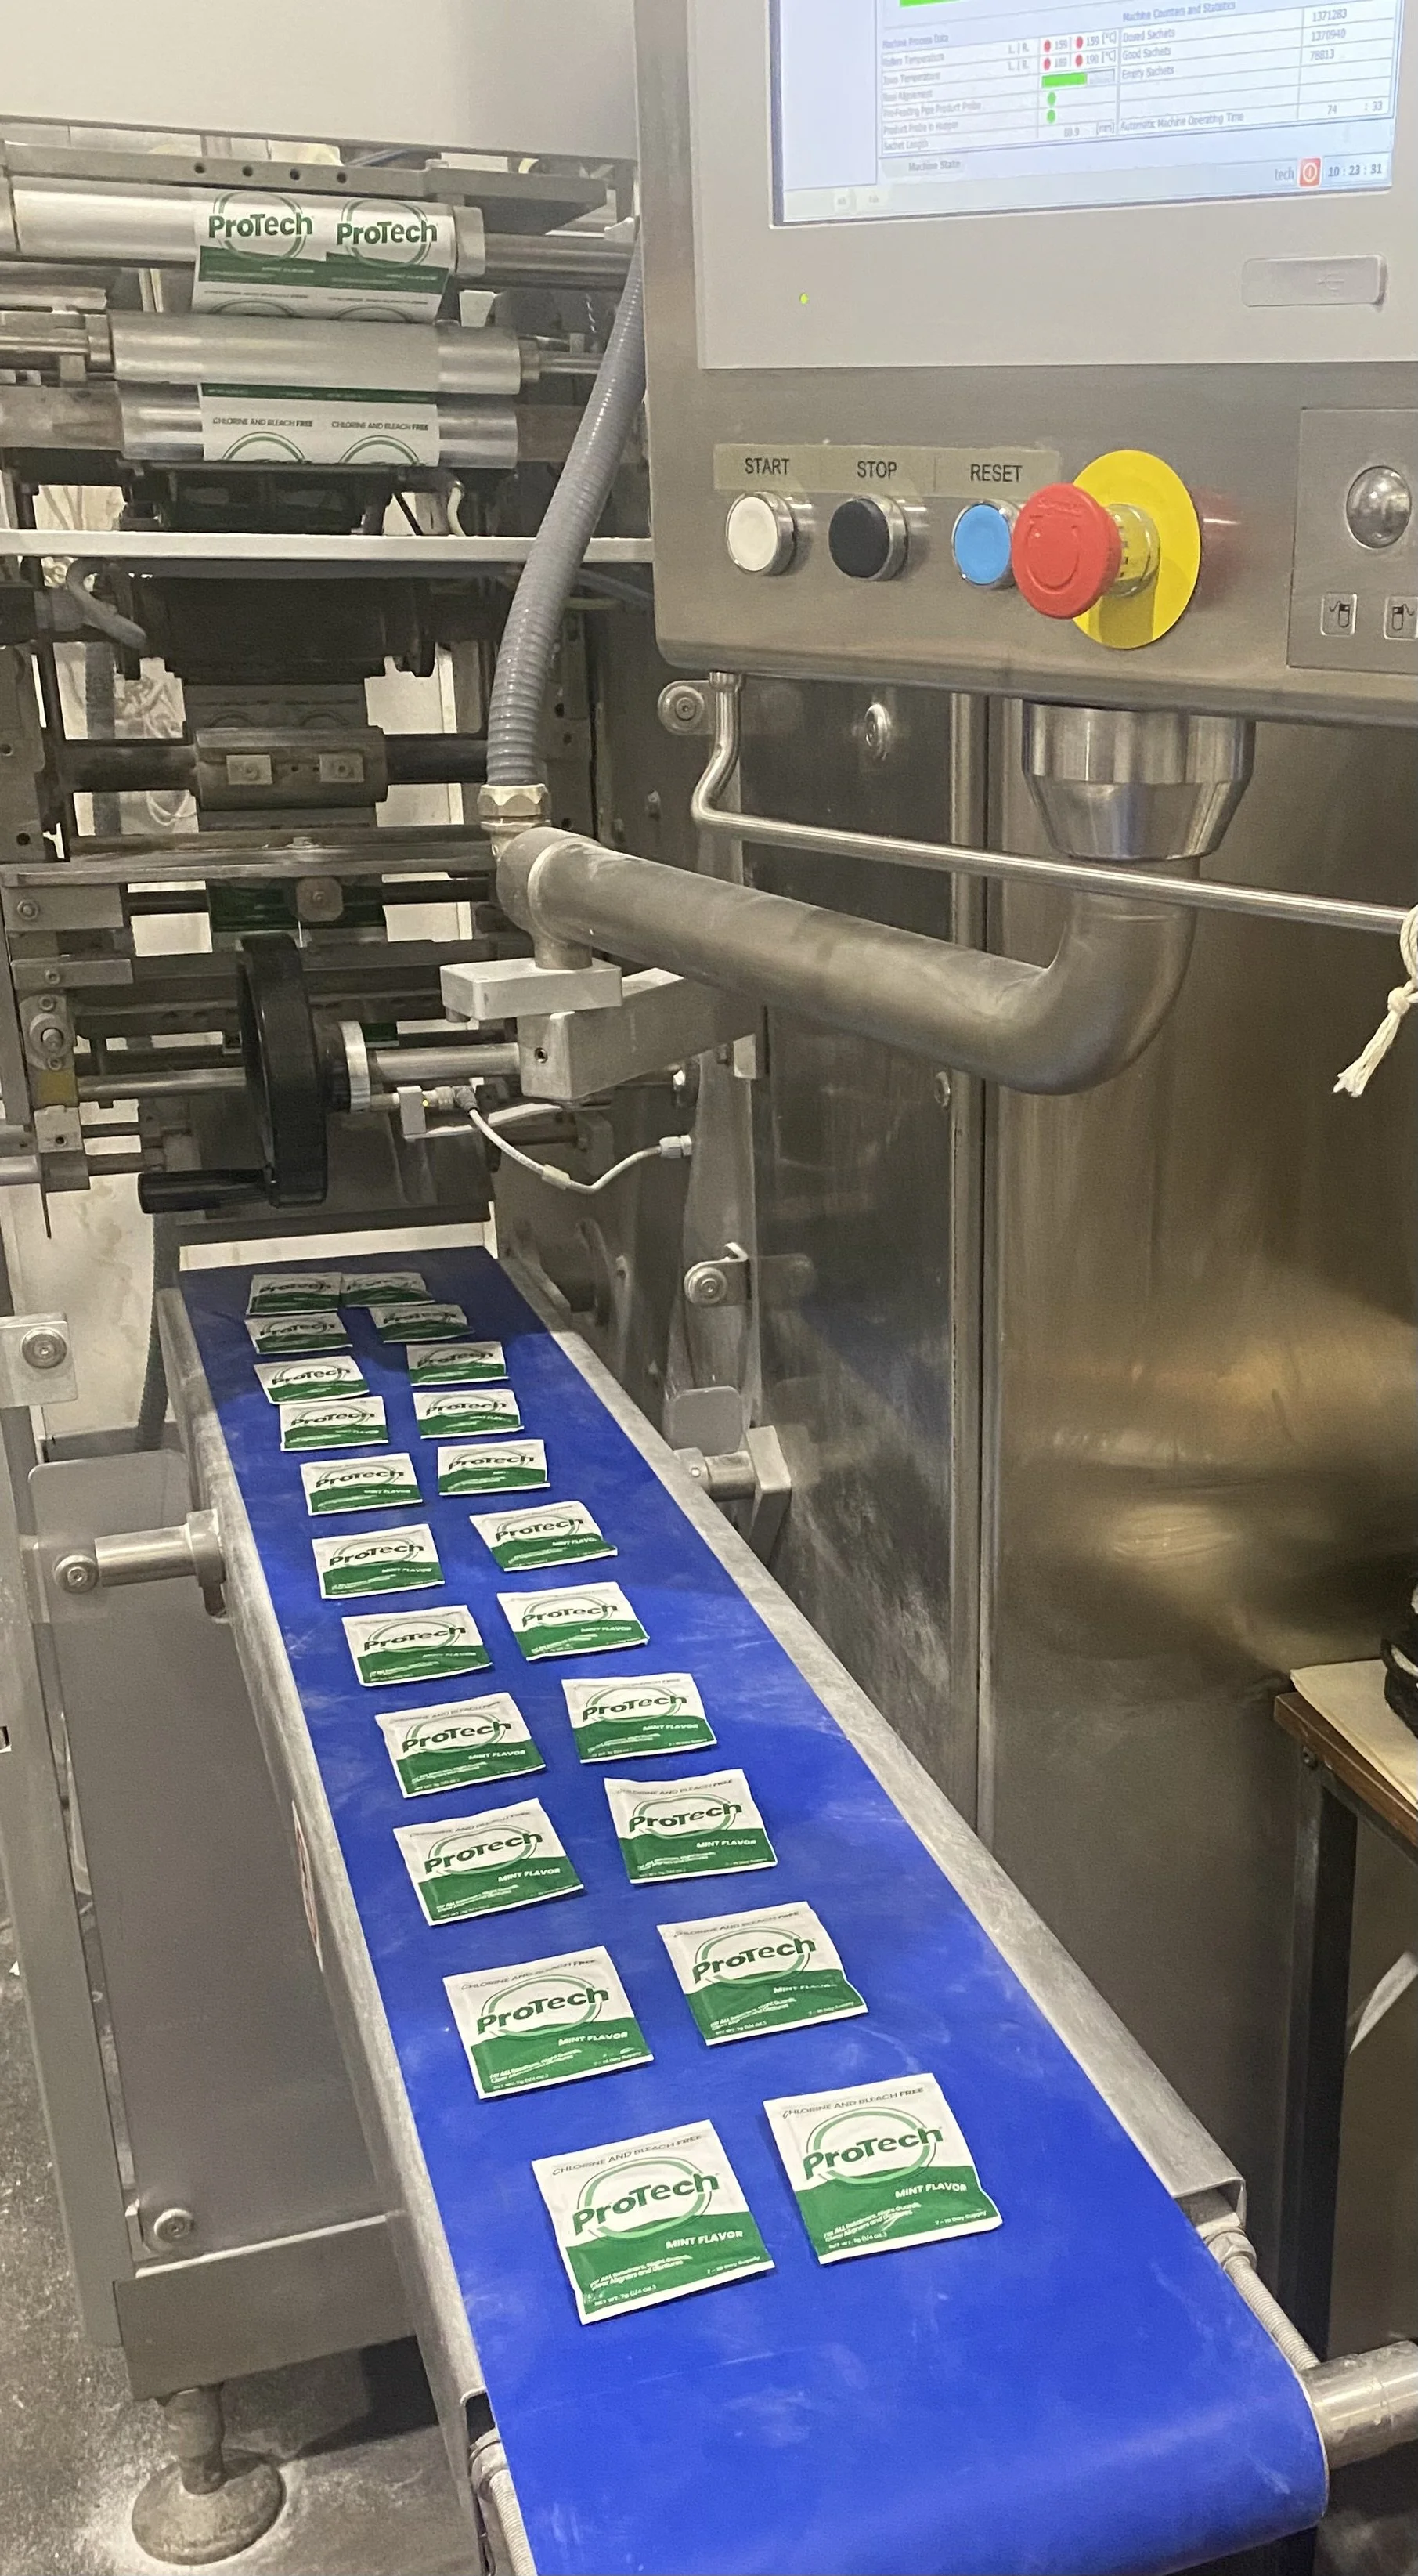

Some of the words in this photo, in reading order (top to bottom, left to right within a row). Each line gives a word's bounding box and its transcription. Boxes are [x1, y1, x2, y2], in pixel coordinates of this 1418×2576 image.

[1188, 5, 1201, 15] and
[1275, 166, 1294, 181] tech
[208, 212, 313, 238] ProTech
[337, 220, 438, 245] ProTech
[411, 423, 428, 432] FREE
[744, 457, 789, 475] START
[857, 461, 897, 479] STOP
[970, 464, 1023, 482] RESET
[316, 1471, 404, 1488] ProTech
[495, 1519, 584, 1542] ProTech
[329, 1544, 424, 1566] ProTech
[522, 1604, 618, 1628] ProTech
[363, 1627, 466, 1651] ProTech
[582, 1695, 687, 1722] ProTech
[402, 1721, 511, 1753] ProTech
[629, 1803, 742, 1834] ProTech
[424, 1833, 543, 1873] ProTech
[696, 1840, 720, 1848] MINT
[497, 1871, 522, 1882] MINT
[523, 1867, 561, 1877] FLAVOR
[692, 1938, 817, 1984] ProTech
[476, 1987, 609, 2035] ProTech
[558, 2036, 586, 2046] MINT
[587, 2031, 629, 2042] FLAVOR
[782, 2104, 832, 2119] CHLORINE
[858, 2092, 898, 2104] BLEACH
[899, 2086, 924, 2097] FREE
[608, 2151, 632, 2162] AND
[633, 2142, 675, 2155] BLEACH
[677, 2134, 702, 2146] FREE
[802, 2127, 944, 2180] ProTech
[895, 2185, 924, 2198] MINT
[925, 2182, 967, 2191] FLAVOR
[572, 2173, 720, 2236] ProTech
[666, 2237, 696, 2249] MINT
[698, 2230, 744, 2245] FLAVOR
